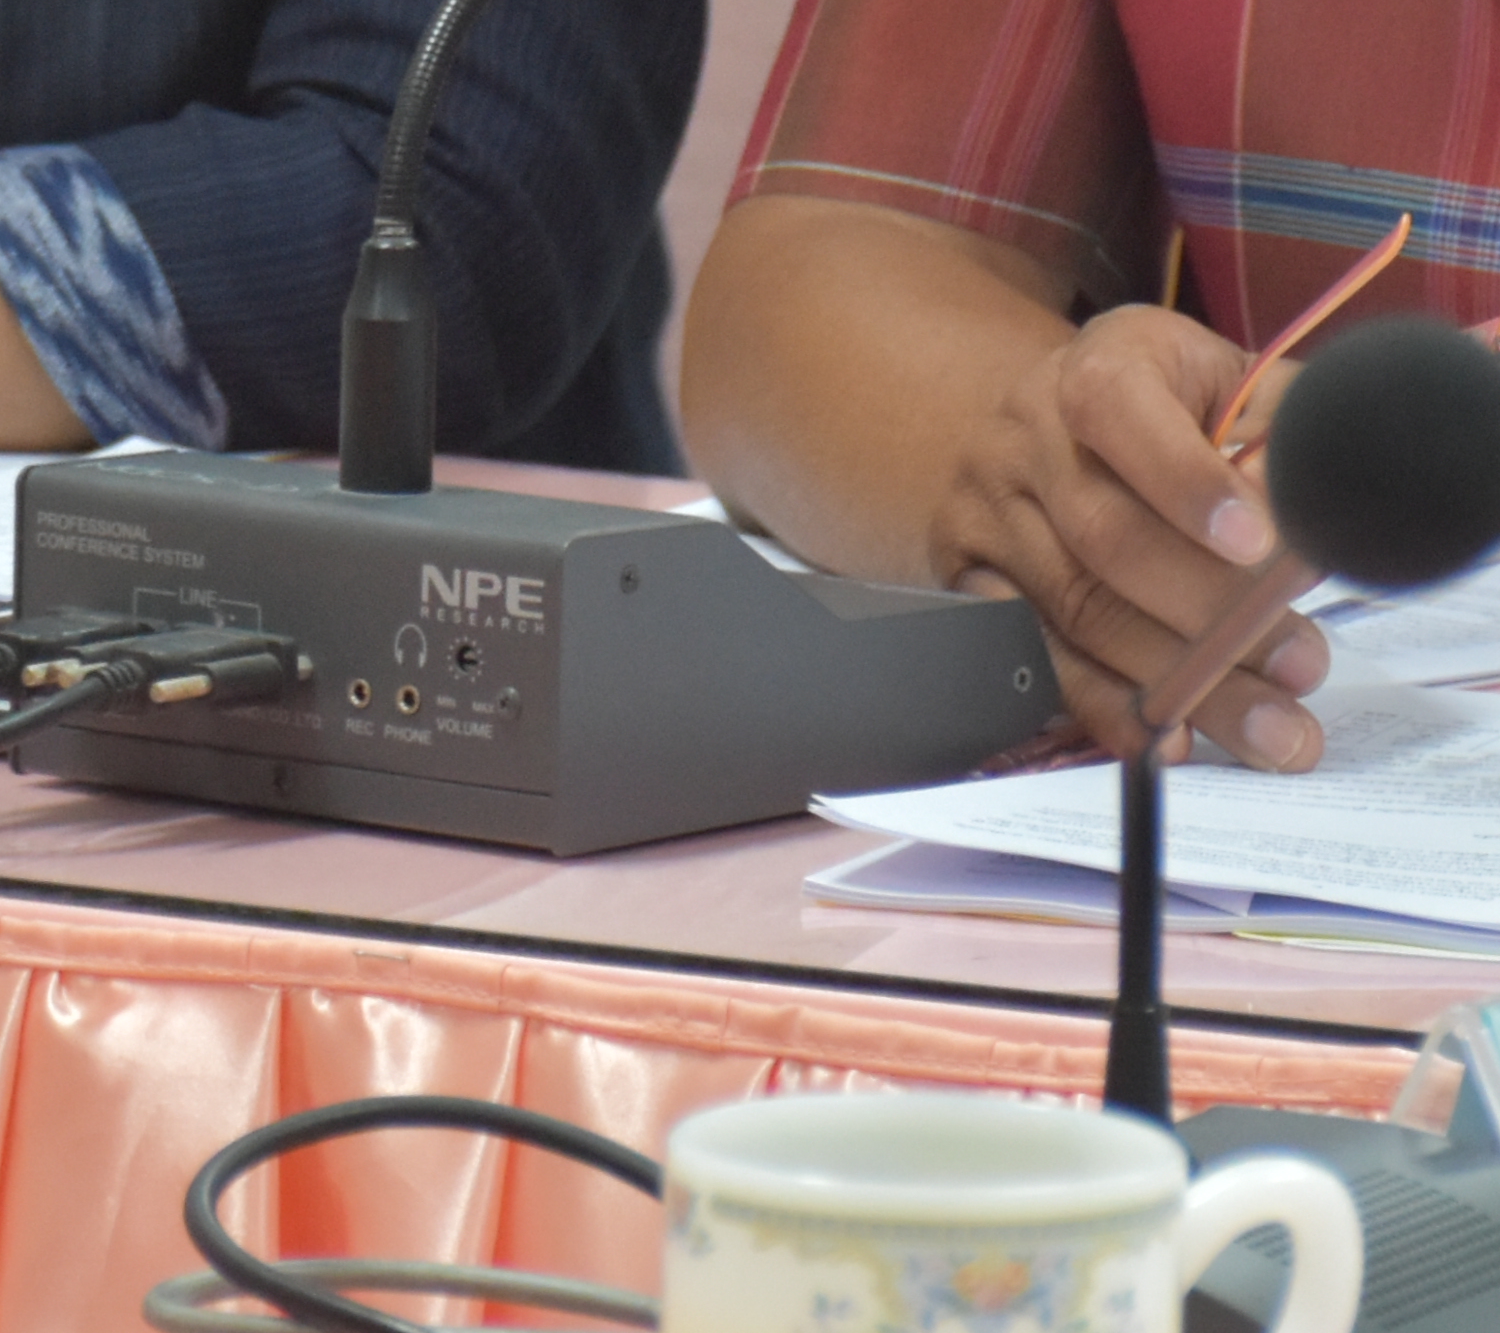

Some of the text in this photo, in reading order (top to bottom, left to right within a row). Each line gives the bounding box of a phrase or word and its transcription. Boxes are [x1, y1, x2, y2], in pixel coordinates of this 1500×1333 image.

[37, 511, 151, 542] PROFESSIONAL
[37, 532, 206, 569] CONFERENCE SYSTEM
[179, 585, 218, 608] LINE
[421, 564, 545, 620] NPE
[420, 606, 545, 635] RESEARCH
[346, 716, 494, 746] REC PHONE VOLUME
